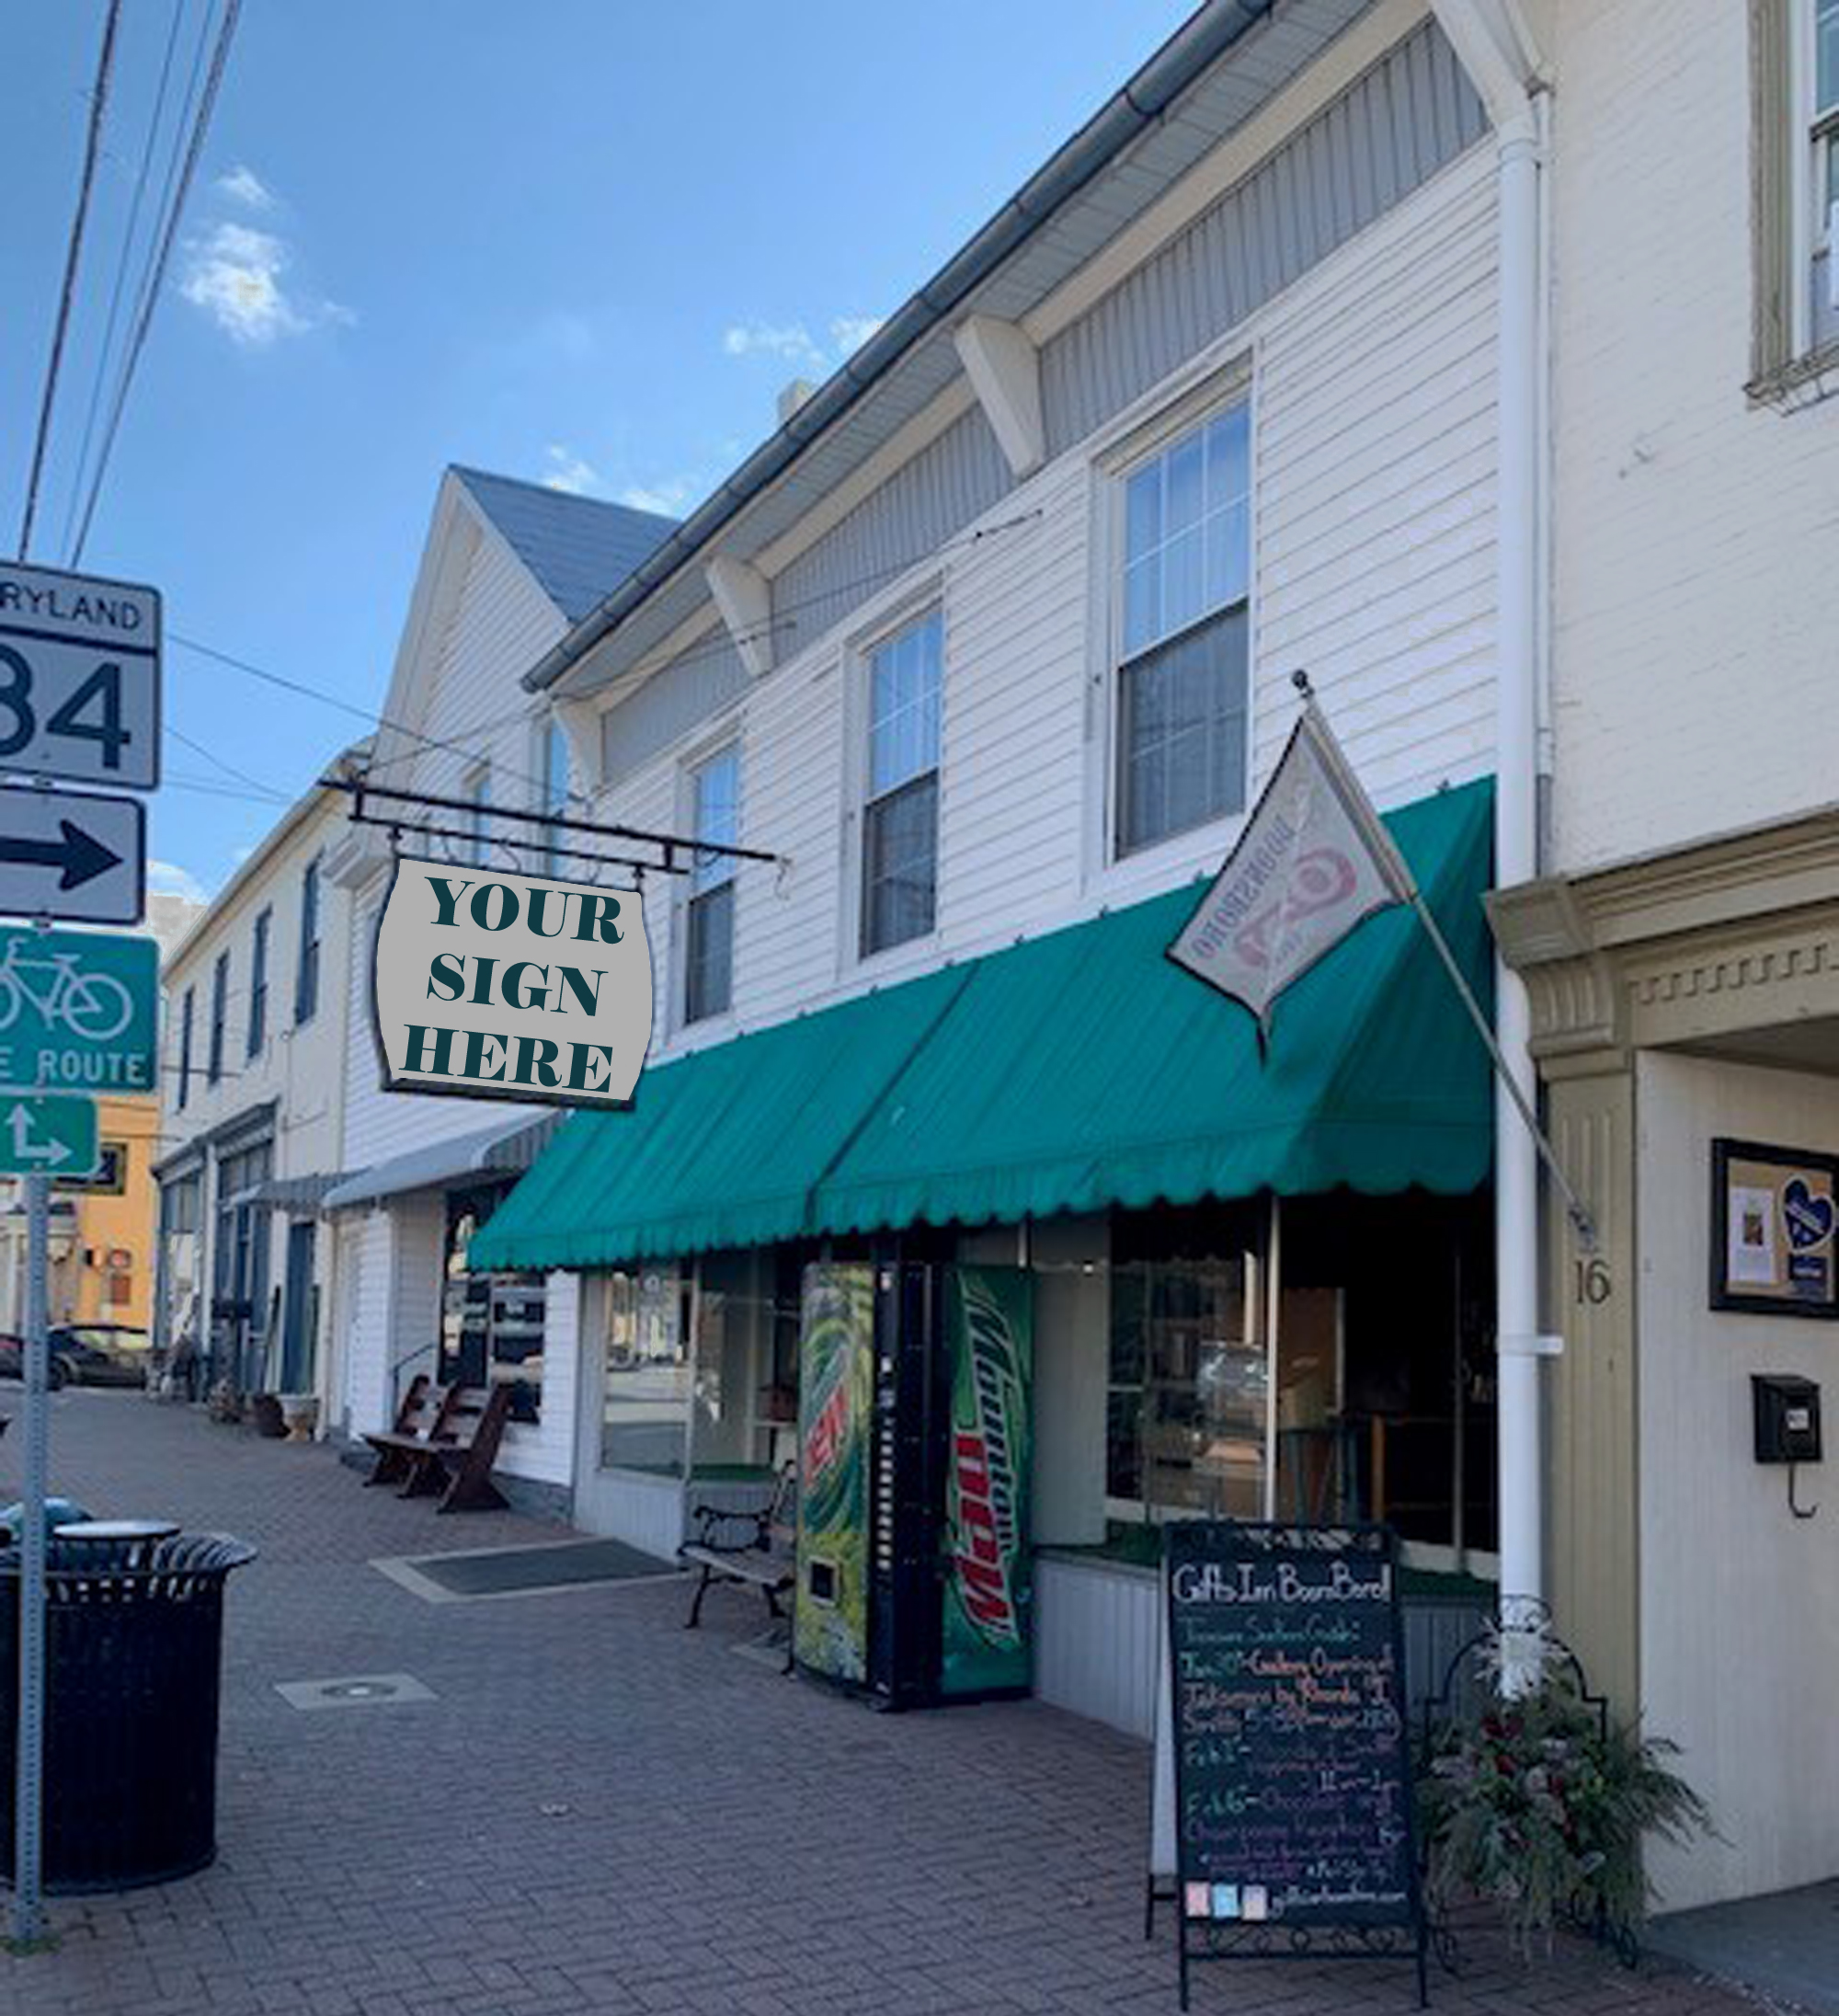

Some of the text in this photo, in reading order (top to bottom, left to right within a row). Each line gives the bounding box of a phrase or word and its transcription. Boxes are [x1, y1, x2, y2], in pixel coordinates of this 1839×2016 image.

[0, 582, 140, 631] RYLAND
[424, 876, 625, 945] YOUR
[427, 953, 609, 1017] SIGN
[38, 1048, 147, 1085] ROUTE
[398, 1024, 613, 1094] HERE
[1573, 1259, 1611, 1304] 16
